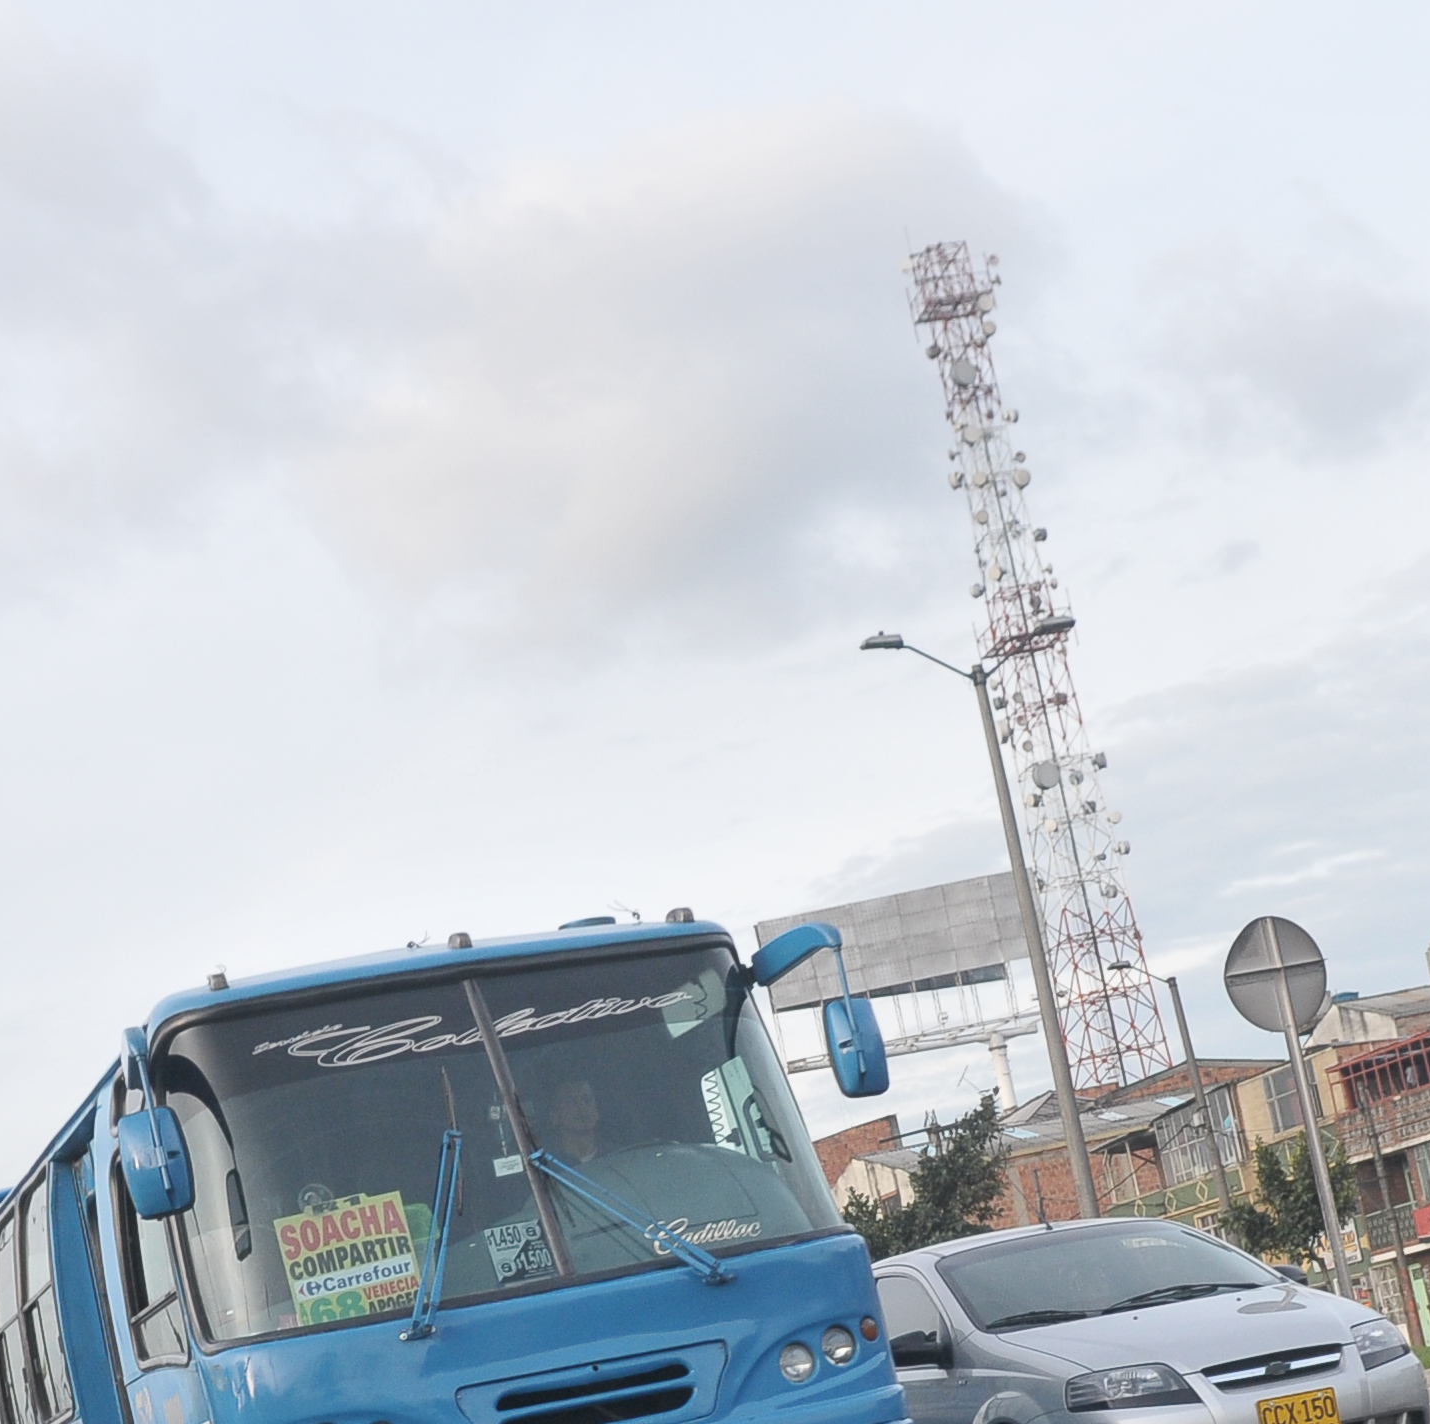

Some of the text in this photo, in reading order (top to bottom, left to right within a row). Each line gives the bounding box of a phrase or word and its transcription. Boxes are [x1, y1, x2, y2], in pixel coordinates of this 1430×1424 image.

[280, 1200, 407, 1260] SOACHA
[644, 1217, 762, 1255] Cadillac
[289, 1235, 412, 1281] COMPARTIR
[323, 1260, 411, 1292] Carrefour
[363, 1275, 420, 1300] VENECIA
[310, 1291, 368, 1324] 68
[1301, 1395, 1336, 1422] 150
